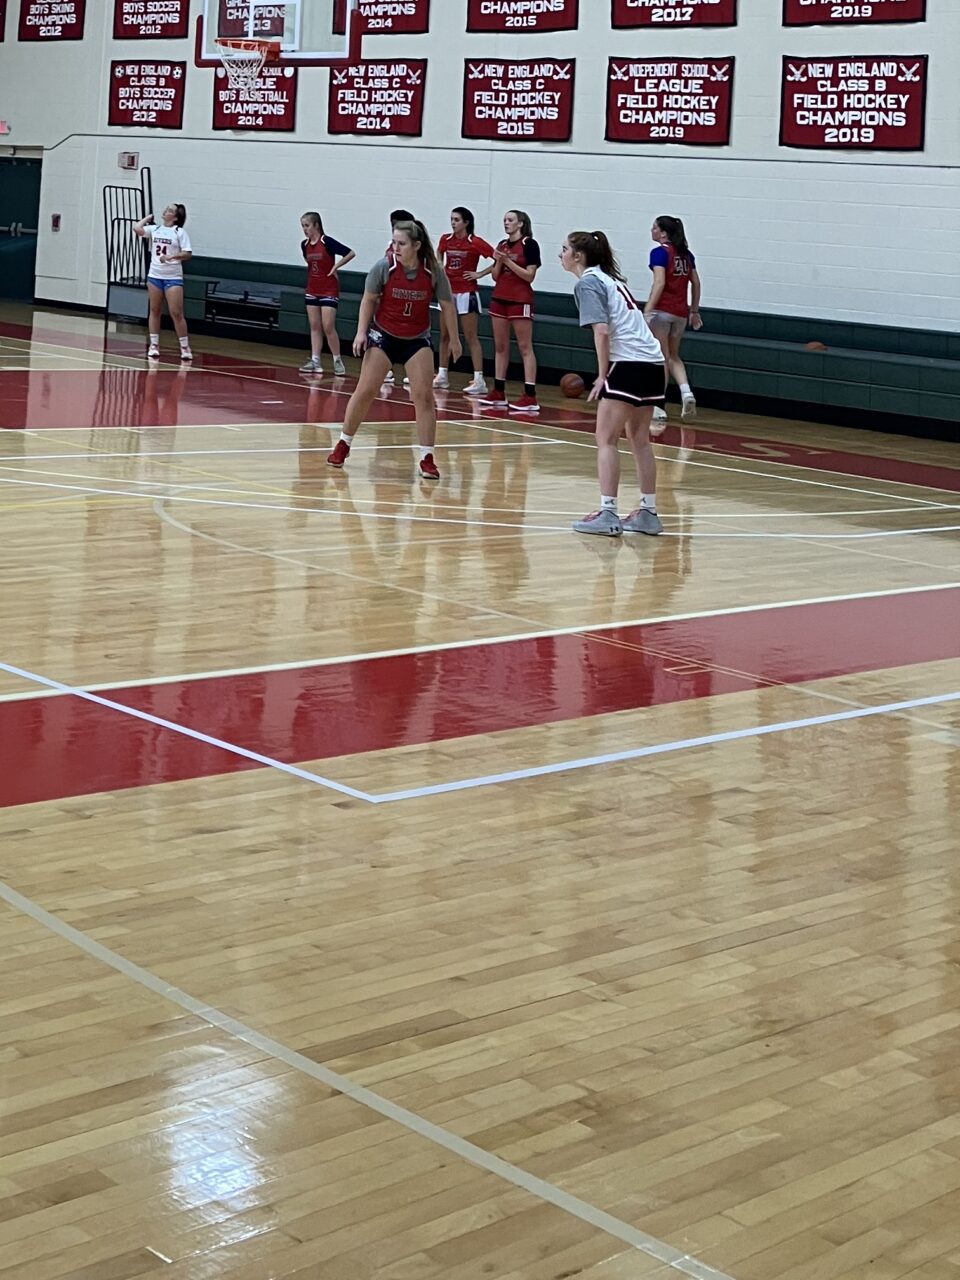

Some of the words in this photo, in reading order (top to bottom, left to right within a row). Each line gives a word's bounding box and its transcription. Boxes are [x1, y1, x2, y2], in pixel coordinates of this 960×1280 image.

[122, 1, 145, 13] BOYS
[146, 0, 180, 12] SOCCER
[830, 5, 872, 17] 2019
[122, 12, 179, 24] CHAMPIONS
[505, 15, 536, 26] 2015
[651, 7, 693, 22] 2017
[139, 24, 161, 34] 2012
[484, 64, 504, 77] NEW
[507, 63, 554, 78] ENGLAND
[681, 63, 710, 77] SCHOOL
[807, 63, 833, 77] NEW
[837, 62, 897, 77] ENGLAND
[490, 79, 531, 90] CLASS
[535, 78, 544, 89] C
[634, 78, 704, 93] LEAGUE
[816, 79, 869, 91] CLASS
[874, 79, 886, 91] B
[473, 91, 508, 104] FIELD
[511, 91, 561, 105] HOCKEY
[617, 93, 657, 108] FIELD
[662, 94, 719, 109] HOCKEY
[793, 93, 838, 108] FIELD
[843, 93, 909, 109] HOCKEY
[475, 105, 559, 120] CHAMPIONS
[619, 109, 716, 125] CHAMPIONS
[796, 110, 906, 126] CHAMPIONS
[497, 121, 534, 135] 2015
[649, 125, 684, 138] 2019
[824, 127, 874, 142] 2019
[156, 245, 168, 256] 24
